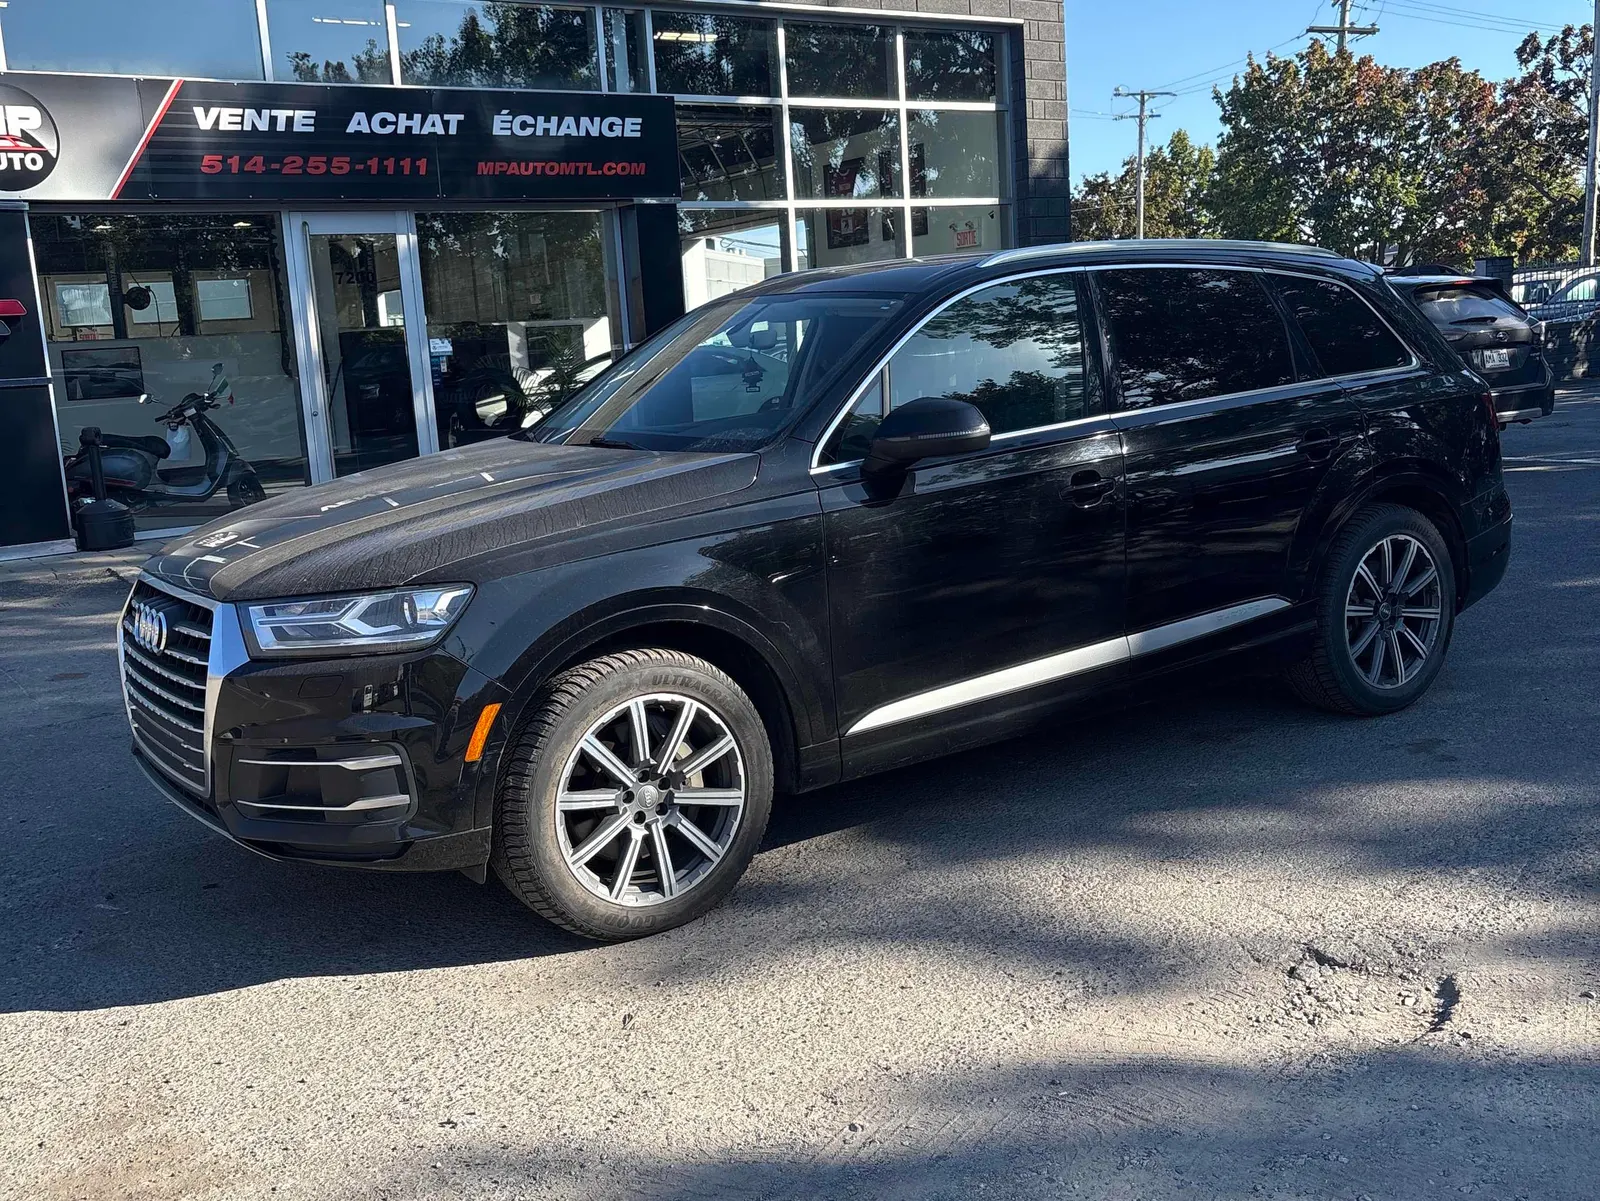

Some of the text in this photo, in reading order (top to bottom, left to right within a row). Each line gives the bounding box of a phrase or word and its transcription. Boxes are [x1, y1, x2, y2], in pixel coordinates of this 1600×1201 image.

[193, 107, 642, 137] VENTE ACHAT ÉCHANGE
[200, 155, 427, 175] 514-255-1111
[477, 161, 645, 175] MPAUTOMTL.COM
[956, 230, 977, 247] SORTIE
